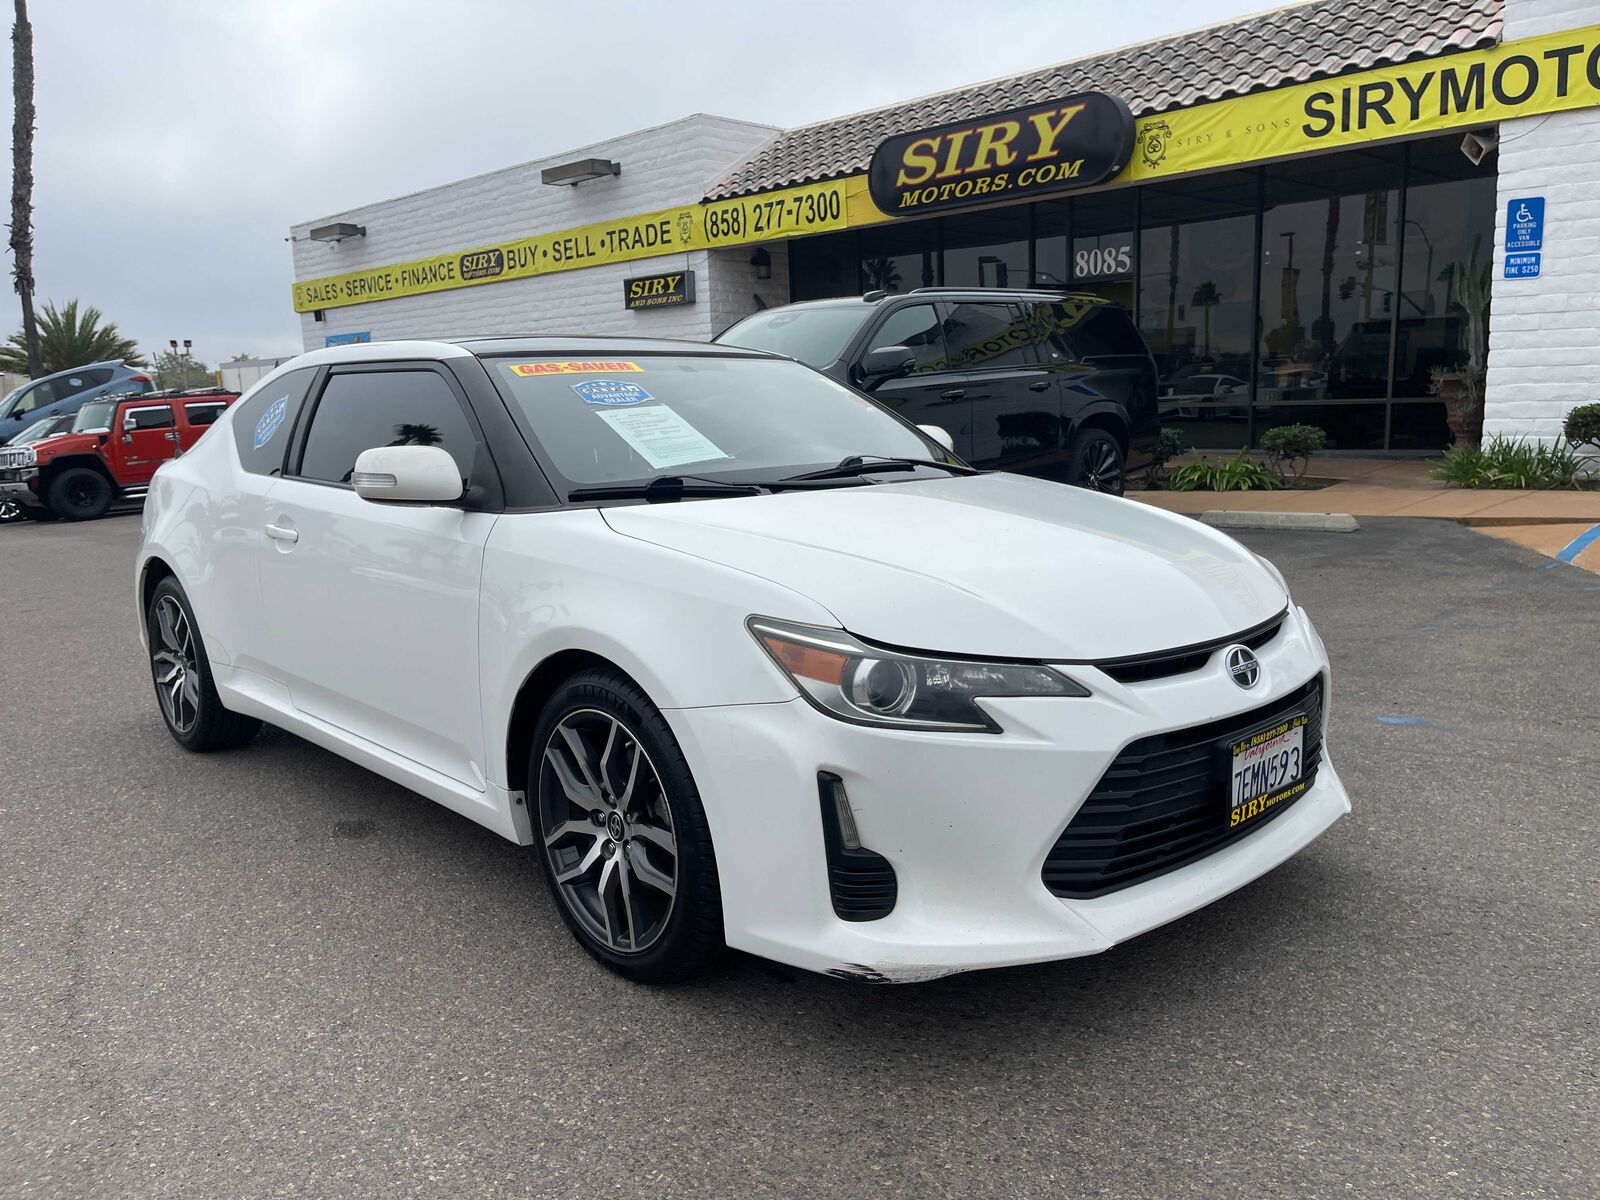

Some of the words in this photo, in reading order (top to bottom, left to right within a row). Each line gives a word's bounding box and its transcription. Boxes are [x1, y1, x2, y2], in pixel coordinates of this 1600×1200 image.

[1302, 43, 1600, 138] SIRYMOT
[896, 103, 1085, 187] SIRY
[1176, 133, 1214, 148] SIRY
[1245, 118, 1291, 135] SONS
[898, 159, 1085, 208] MOTORS.COM
[703, 202, 747, 243] (858)
[753, 190, 840, 233] 277-7300
[507, 245, 538, 270] BUY
[553, 236, 596, 263] SELL
[606, 220, 672, 252] TRADE
[1507, 240, 1540, 248] ACCESSIBLE
[463, 251, 500, 271] SIRY
[1076, 246, 1131, 276] 8085
[1505, 266, 1518, 274] FINE
[1510, 256, 1536, 265] MINIMUM
[306, 284, 338, 303] SALES
[347, 273, 392, 297] SERVICE
[401, 261, 455, 287] FINANCE
[630, 275, 681, 298] SIRY
[630, 299, 646, 308] AND
[646, 297, 667, 305] SONS
[668, 295, 683, 303] INC
[519, 362, 636, 374] GAS-SAVER
[1234, 746, 1300, 806] 7EMN593
[1230, 792, 1268, 827] SIRY
[1266, 783, 1305, 808] MOTORS.COM
